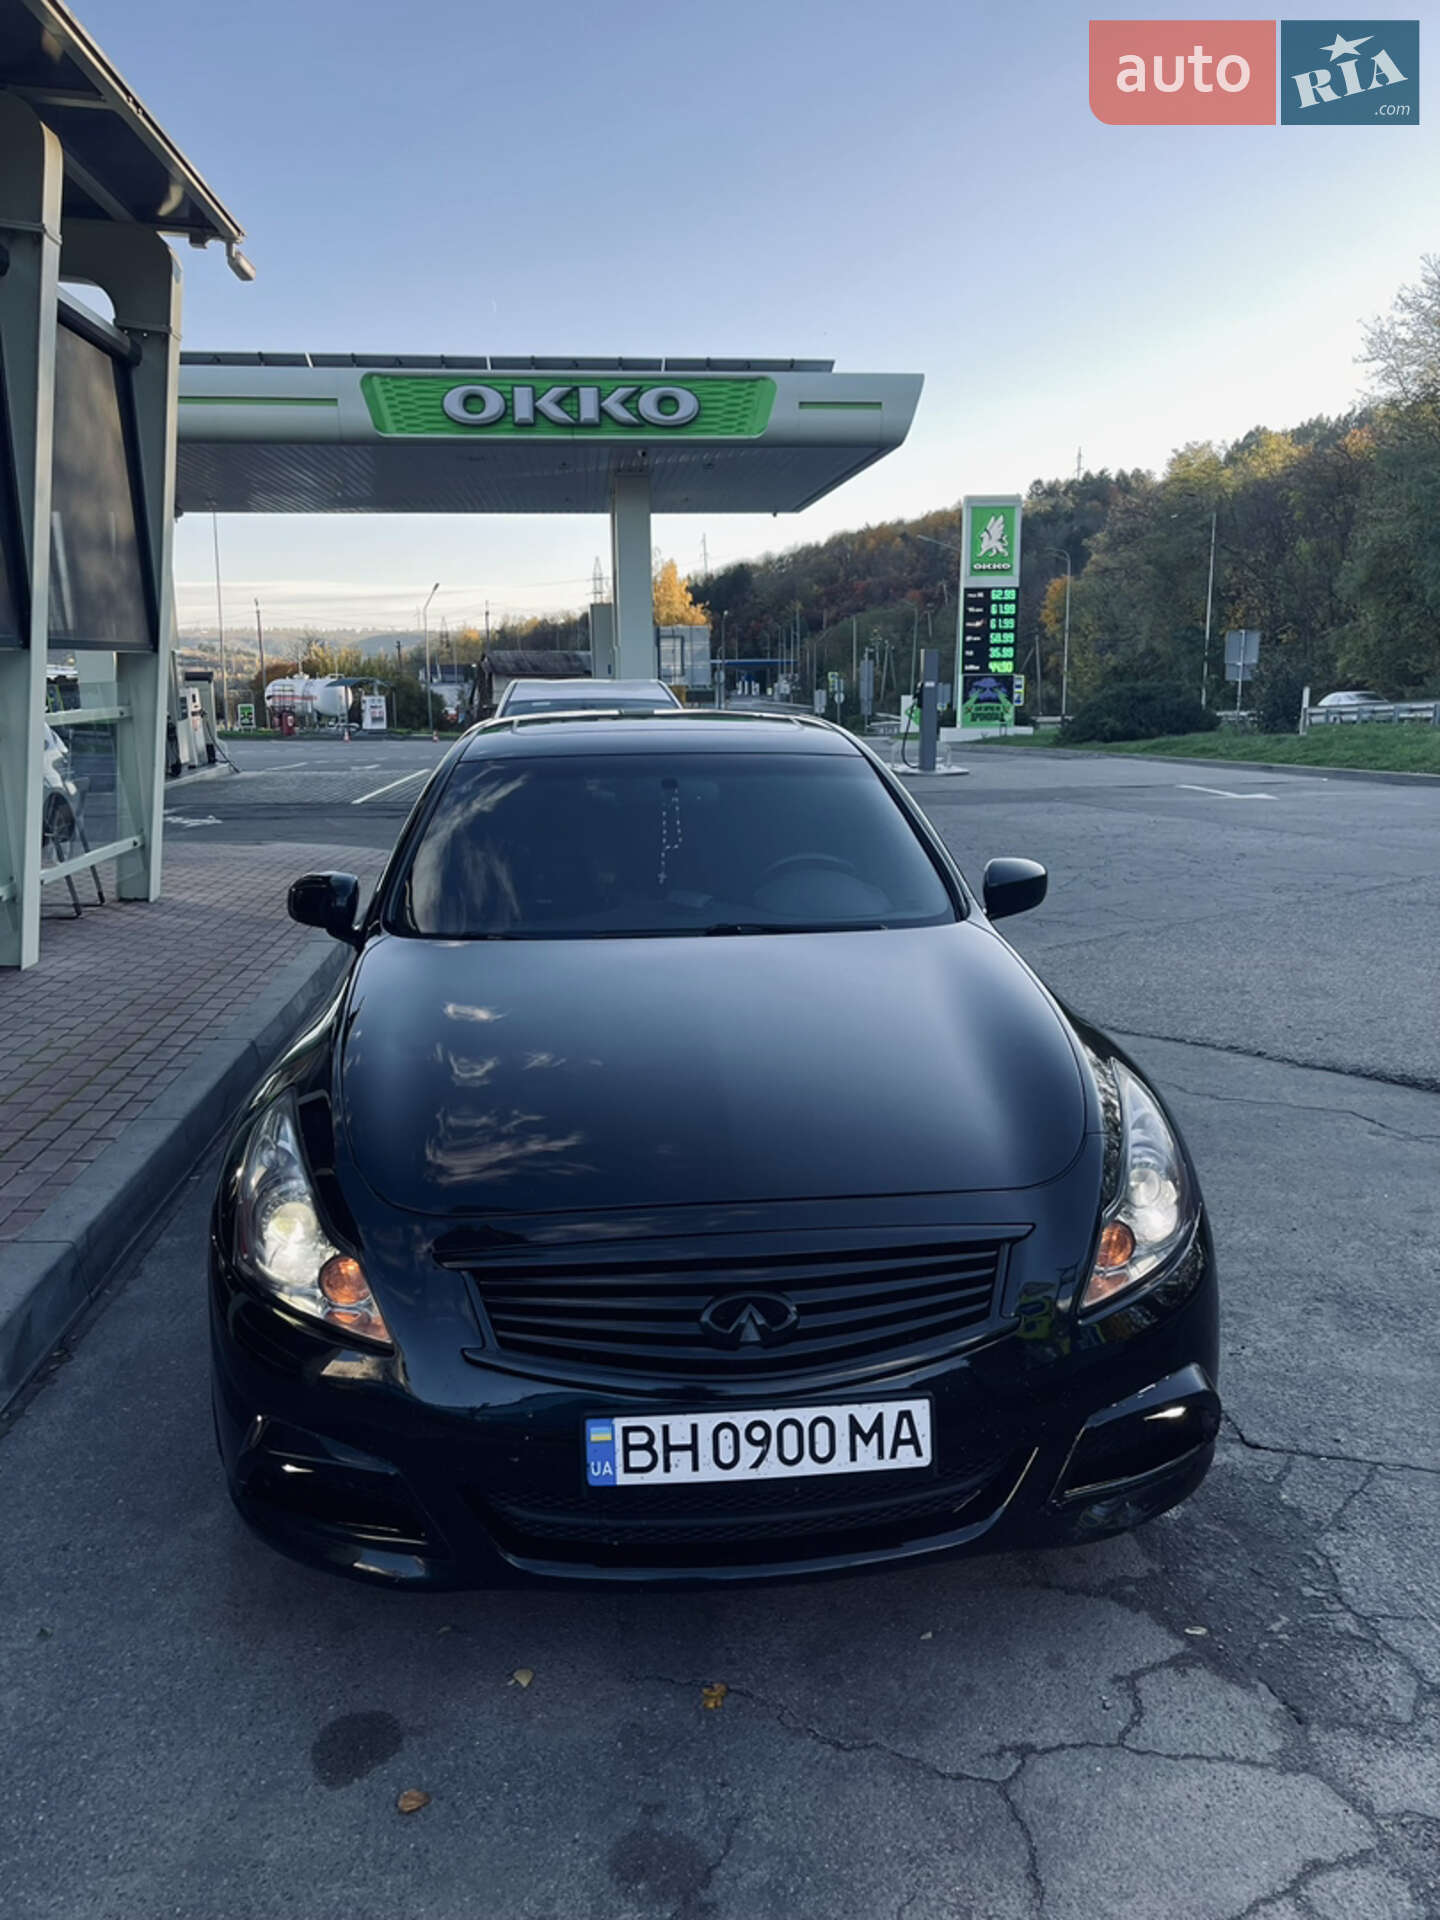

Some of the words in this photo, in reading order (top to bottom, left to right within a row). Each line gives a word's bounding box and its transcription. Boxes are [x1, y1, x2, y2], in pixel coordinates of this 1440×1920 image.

[442, 384, 700, 426] OKKO
[621, 1423, 700, 1474] BH
[711, 1416, 837, 1470] 0900
[848, 1409, 924, 1462] MA
[590, 1461, 613, 1476] UA
